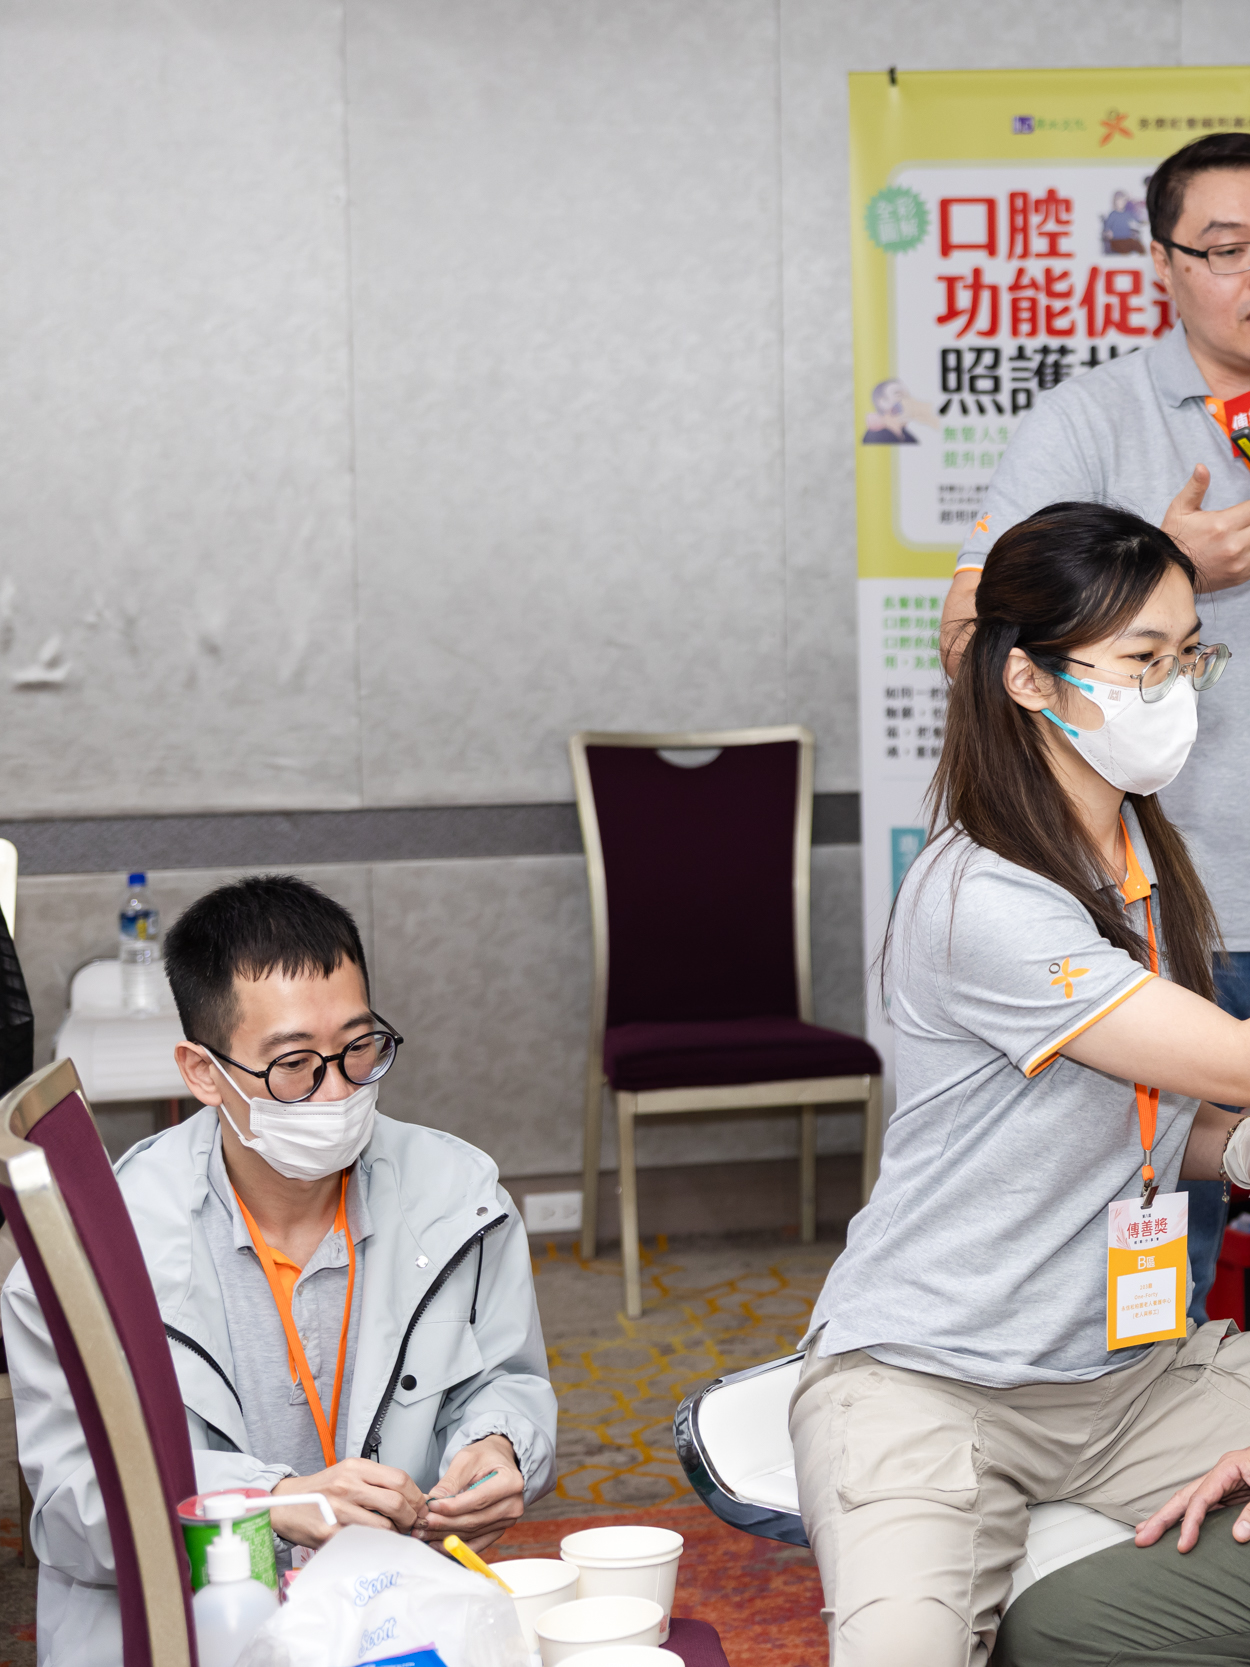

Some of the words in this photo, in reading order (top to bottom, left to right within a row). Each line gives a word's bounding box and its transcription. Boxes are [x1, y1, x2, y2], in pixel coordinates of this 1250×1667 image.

[938, 188, 1075, 262] 口腔
[1127, 1217, 1168, 1239] 傳善獎
[1138, 1255, 1156, 1270] B區
[358, 1616, 398, 1658] Scott
